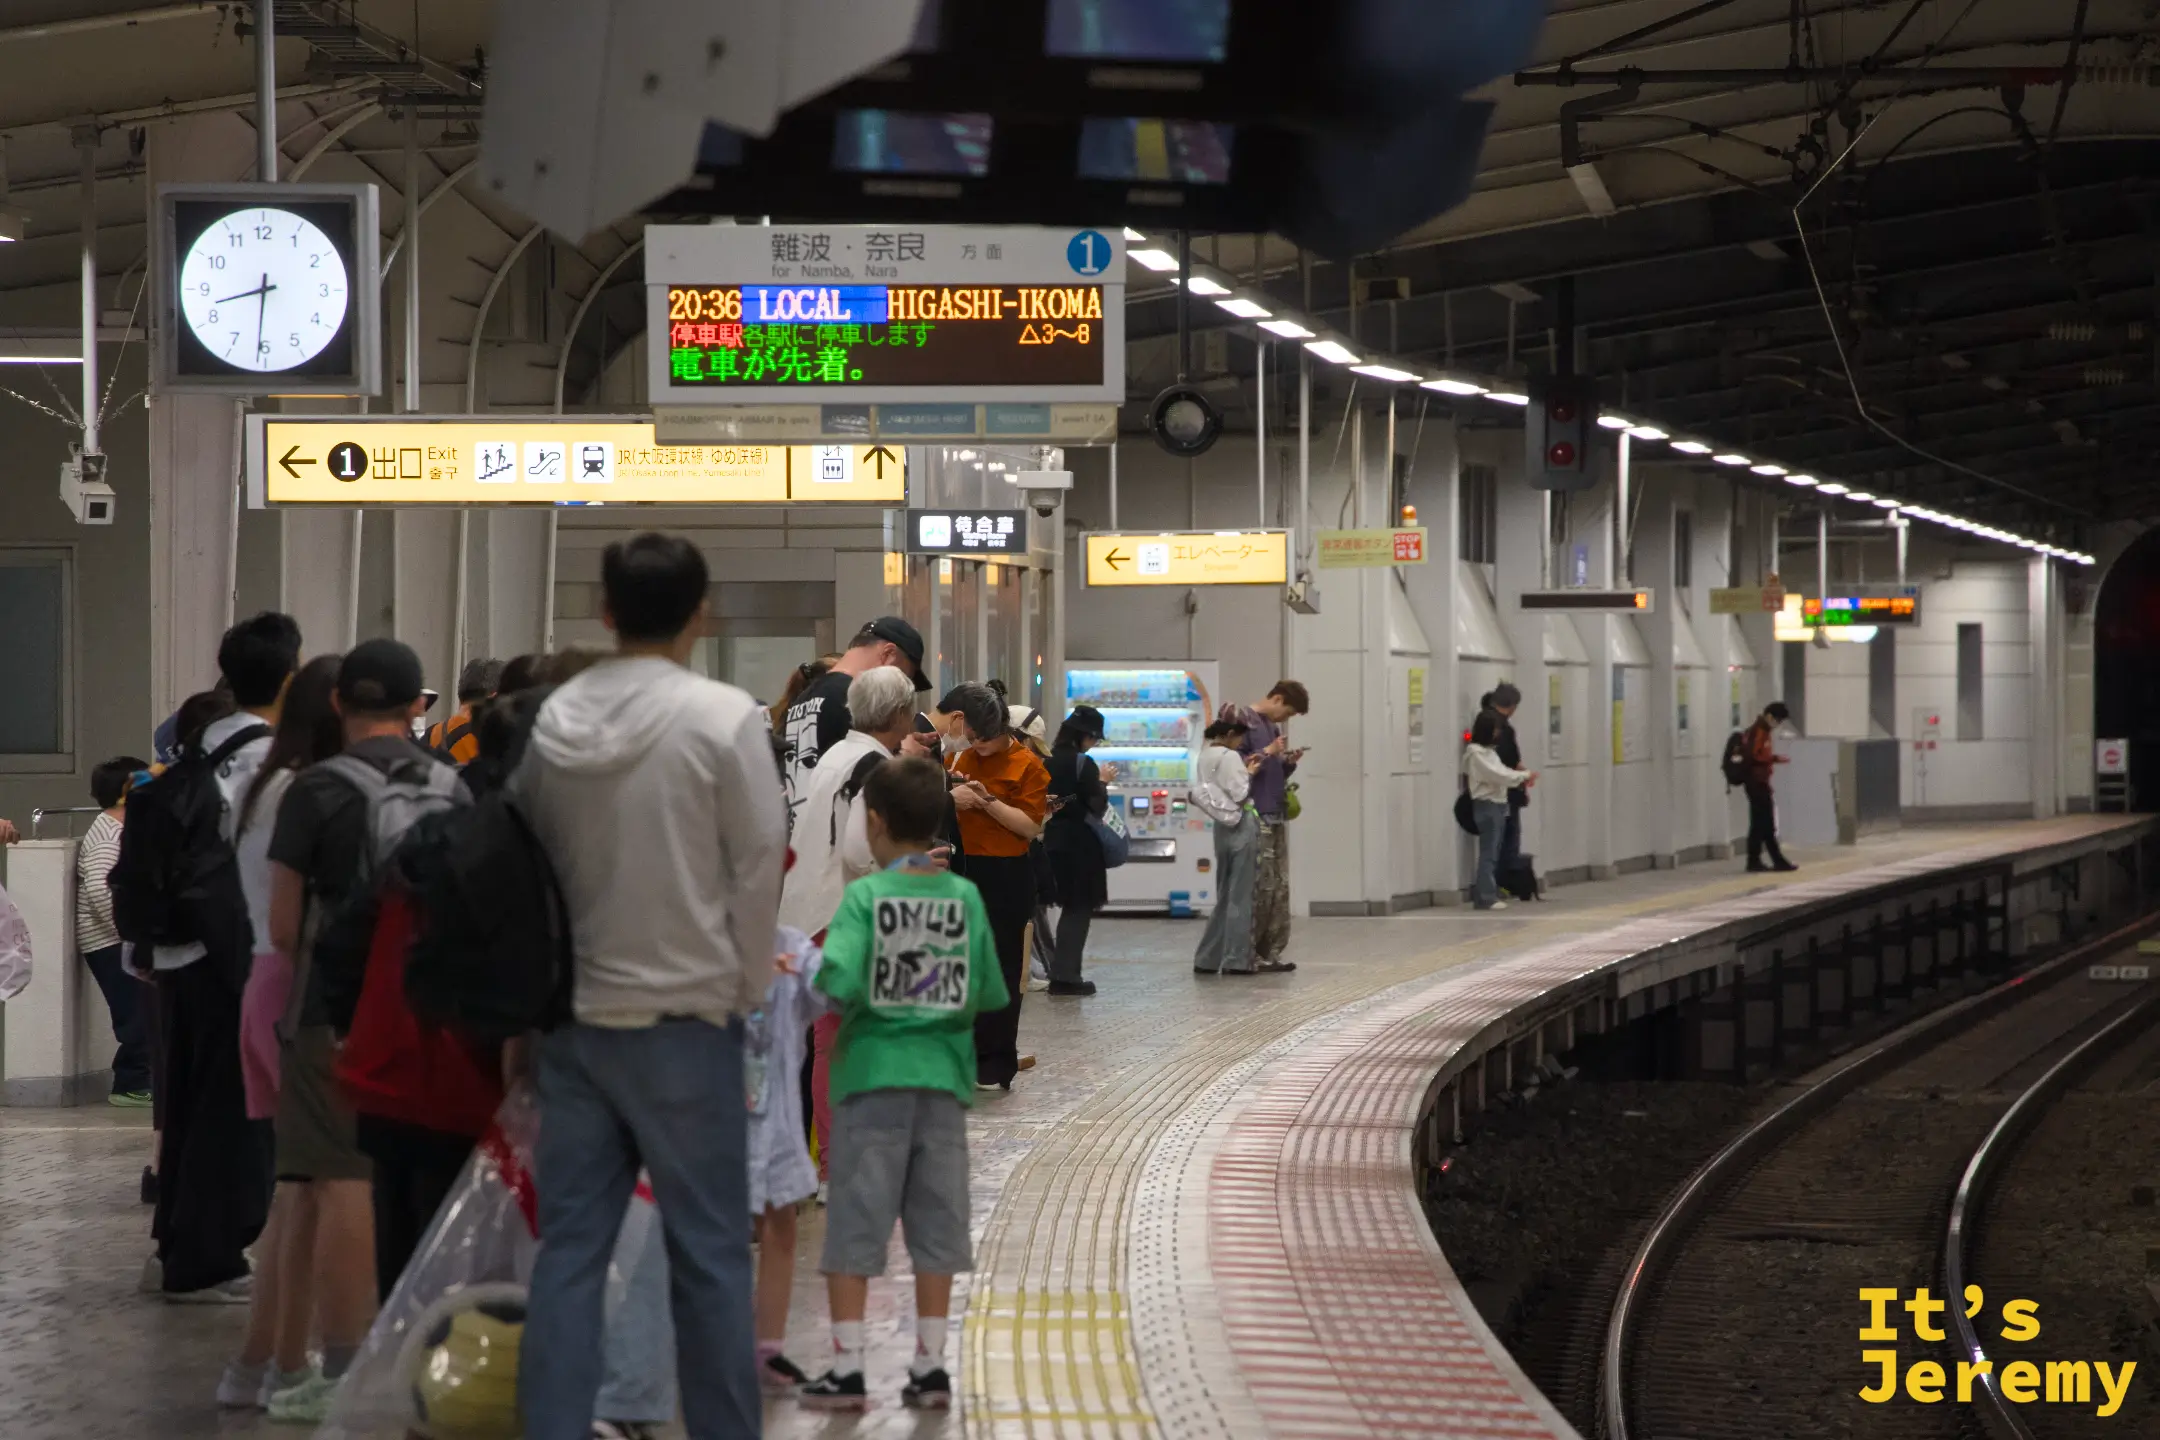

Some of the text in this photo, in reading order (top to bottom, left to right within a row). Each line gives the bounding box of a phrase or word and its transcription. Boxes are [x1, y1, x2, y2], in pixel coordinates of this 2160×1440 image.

[254, 226, 272, 240] 12
[229, 234, 243, 248] 11
[290, 234, 297, 248] 1
[772, 233, 1002, 262] 難波・奈良 方面
[1080, 234, 1099, 273] 1
[208, 255, 225, 270] 10
[310, 254, 320, 268] 2
[771, 265, 898, 279] for Namba, Nara
[200, 283, 210, 296] 9
[319, 284, 329, 297] 3
[669, 287, 1103, 320] 20:36 LOCAL HIGASHI-IKOMA
[209, 309, 219, 323] 8
[310, 312, 320, 325] 4
[230, 332, 240, 346] 7
[290, 333, 300, 347] 5
[261, 340, 270, 354] 6
[671, 346, 863, 382] 電車が先着。
[428, 446, 458, 460] Exit
[340, 446, 422, 480] 1 出口
[429, 466, 458, 480] 출구
[1394, 534, 1420, 544] STOP
[1173, 543, 1269, 560] エレベーター
[878, 900, 966, 939] ONLY
